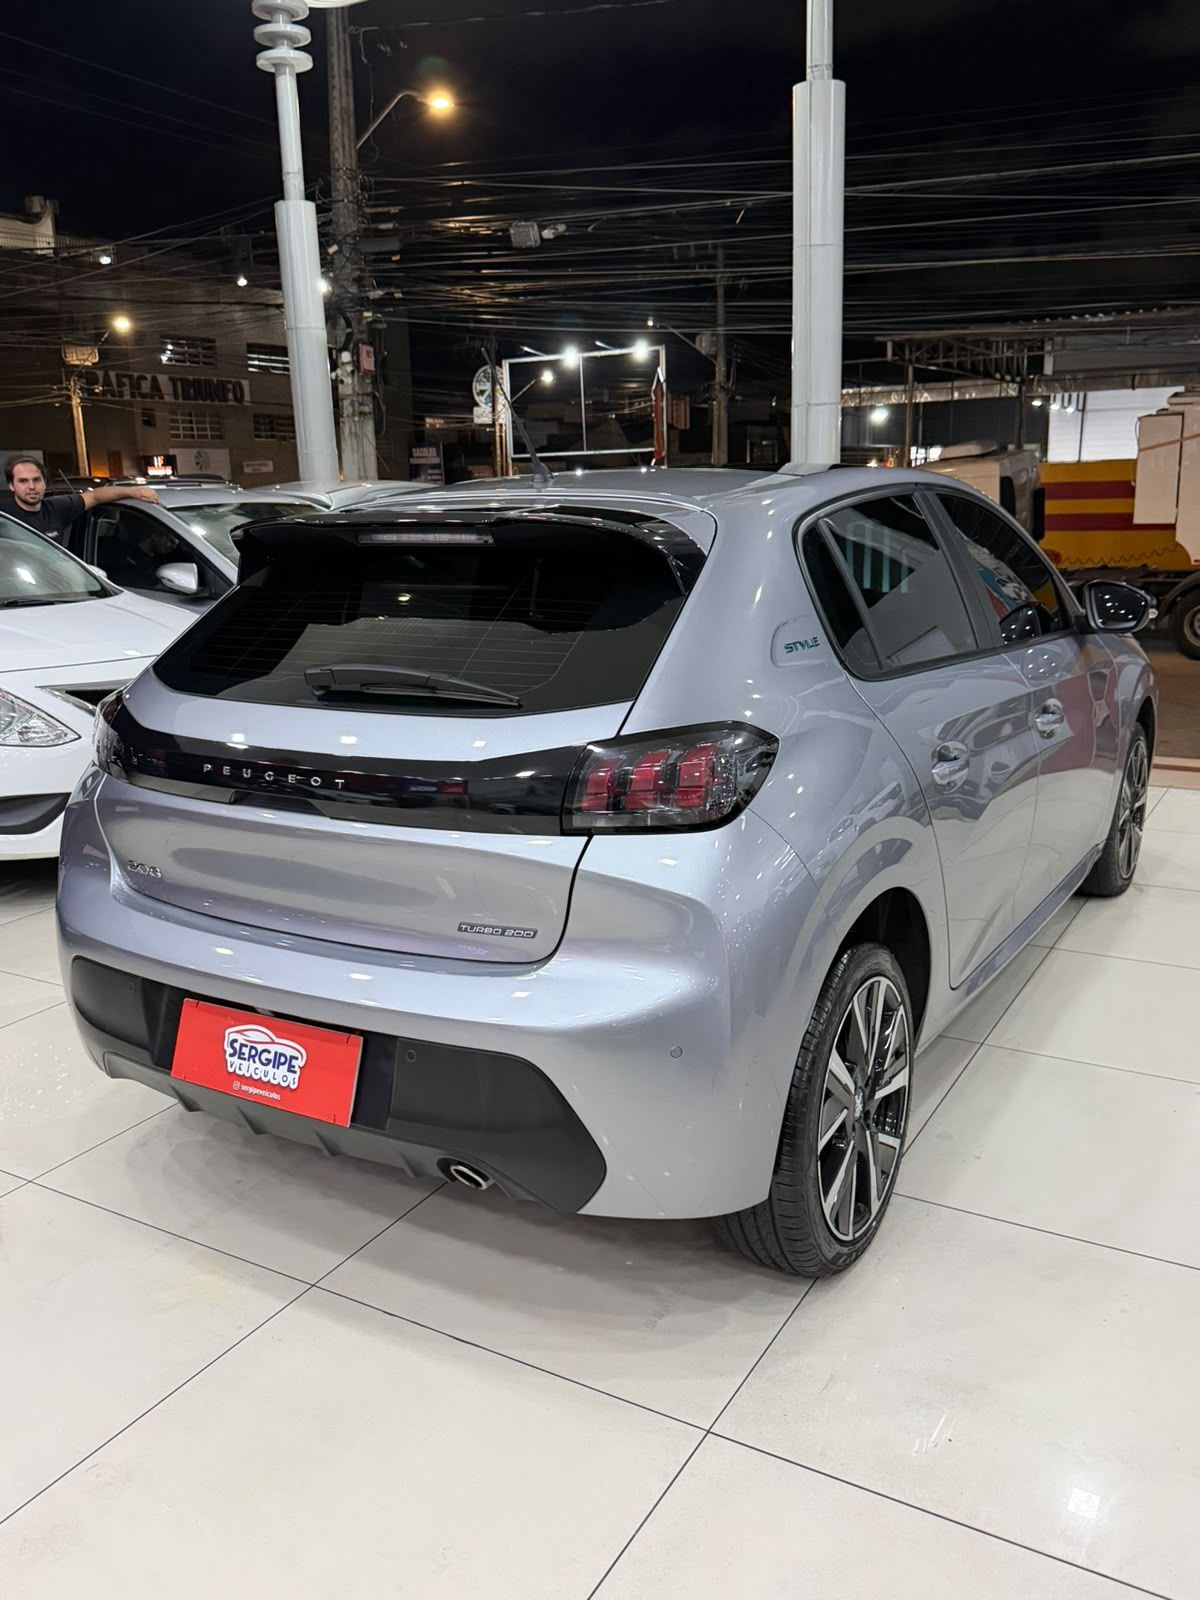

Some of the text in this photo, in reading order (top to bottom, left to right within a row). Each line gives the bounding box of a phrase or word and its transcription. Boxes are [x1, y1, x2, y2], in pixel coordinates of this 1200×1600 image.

[169, 376, 245, 404] TRIUNFO
[784, 636, 820, 654] STYLE
[203, 763, 345, 789] PEUGEOT
[460, 924, 534, 938] TURBO 200
[228, 1038, 299, 1074] SERGIPE
[229, 1060, 296, 1085] VEÍCULOS
[240, 1084, 281, 1100] sergipeveiculos
